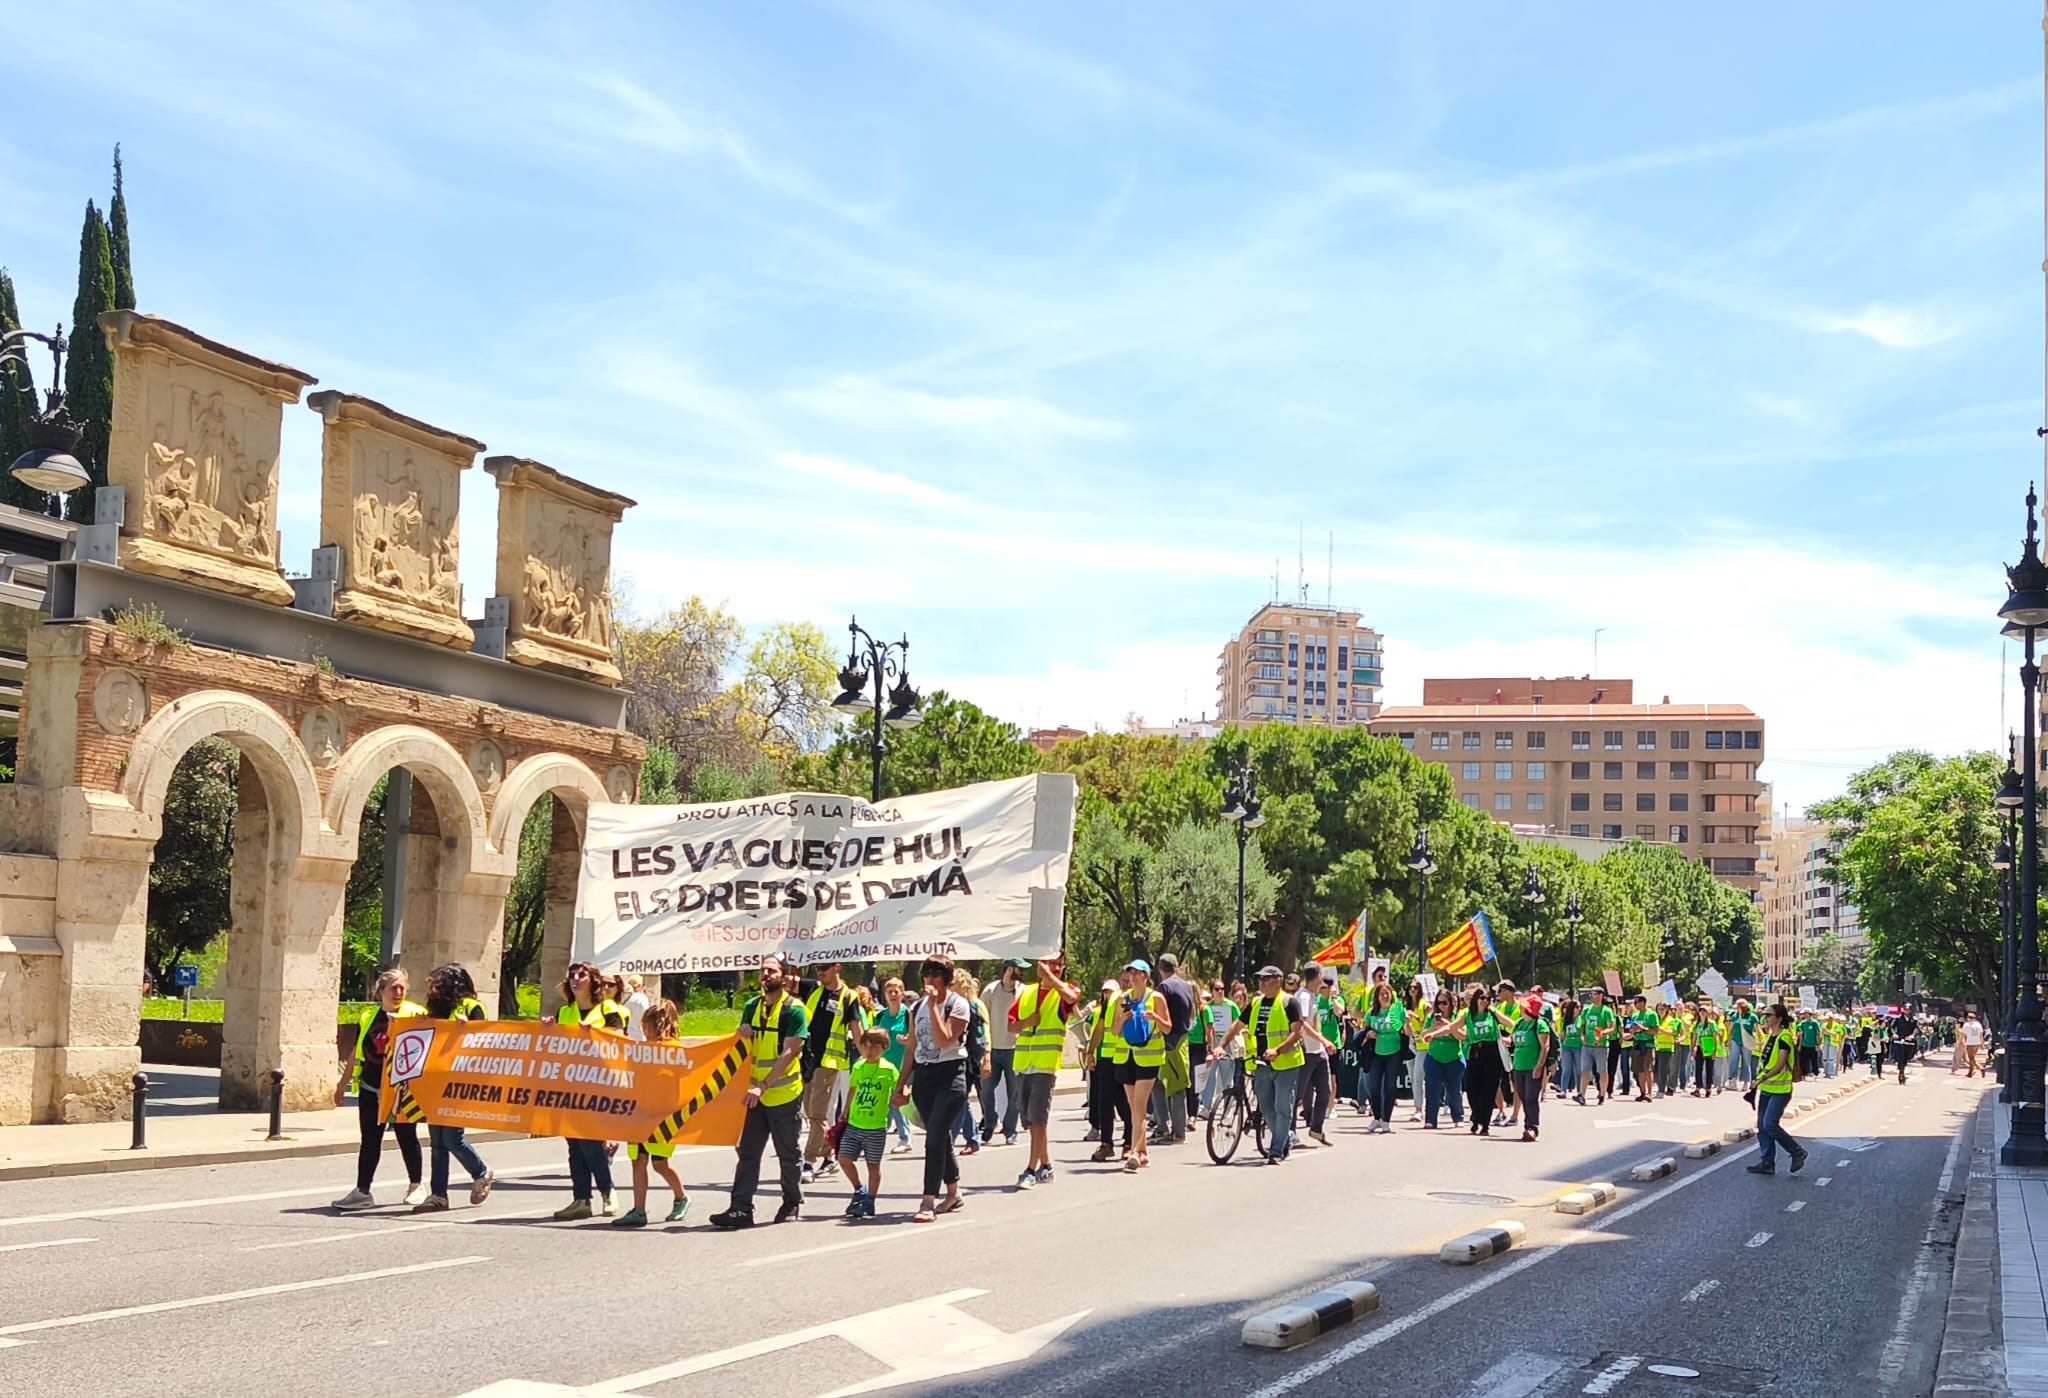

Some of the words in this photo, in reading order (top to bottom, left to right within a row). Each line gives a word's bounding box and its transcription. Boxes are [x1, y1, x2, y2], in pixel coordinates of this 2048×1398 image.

[677, 806, 731, 821] PROU
[737, 799, 798, 817] ATACS
[804, 803, 817, 816] A
[821, 804, 843, 818] LA
[612, 845, 677, 879] LES
[682, 838, 841, 873] VAGUES
[839, 836, 885, 868] DE
[614, 888, 670, 921] ELS
[676, 877, 808, 912] DRETS
[814, 880, 856, 911] DE
[862, 857, 973, 906] DEMÀ
[619, 953, 687, 973] FORMACIÓ
[807, 944, 880, 962] SECUNDÀRIA
[883, 943, 902, 956] EN
[906, 941, 957, 956] LLUITA
[461, 1032, 532, 1051] DEFENSEM
[535, 1034, 620, 1061] L'EDUCACIÓ
[623, 1041, 695, 1070] PÚBLICA,
[451, 1055, 523, 1077] INCLUSIVA
[528, 1060, 536, 1078] I
[539, 1061, 560, 1081] DE
[564, 1063, 636, 1089] QUALITAT
[442, 1082, 502, 1104] ATUREM
[507, 1086, 532, 1106] LES
[534, 1089, 637, 1116] RETALLADES!
